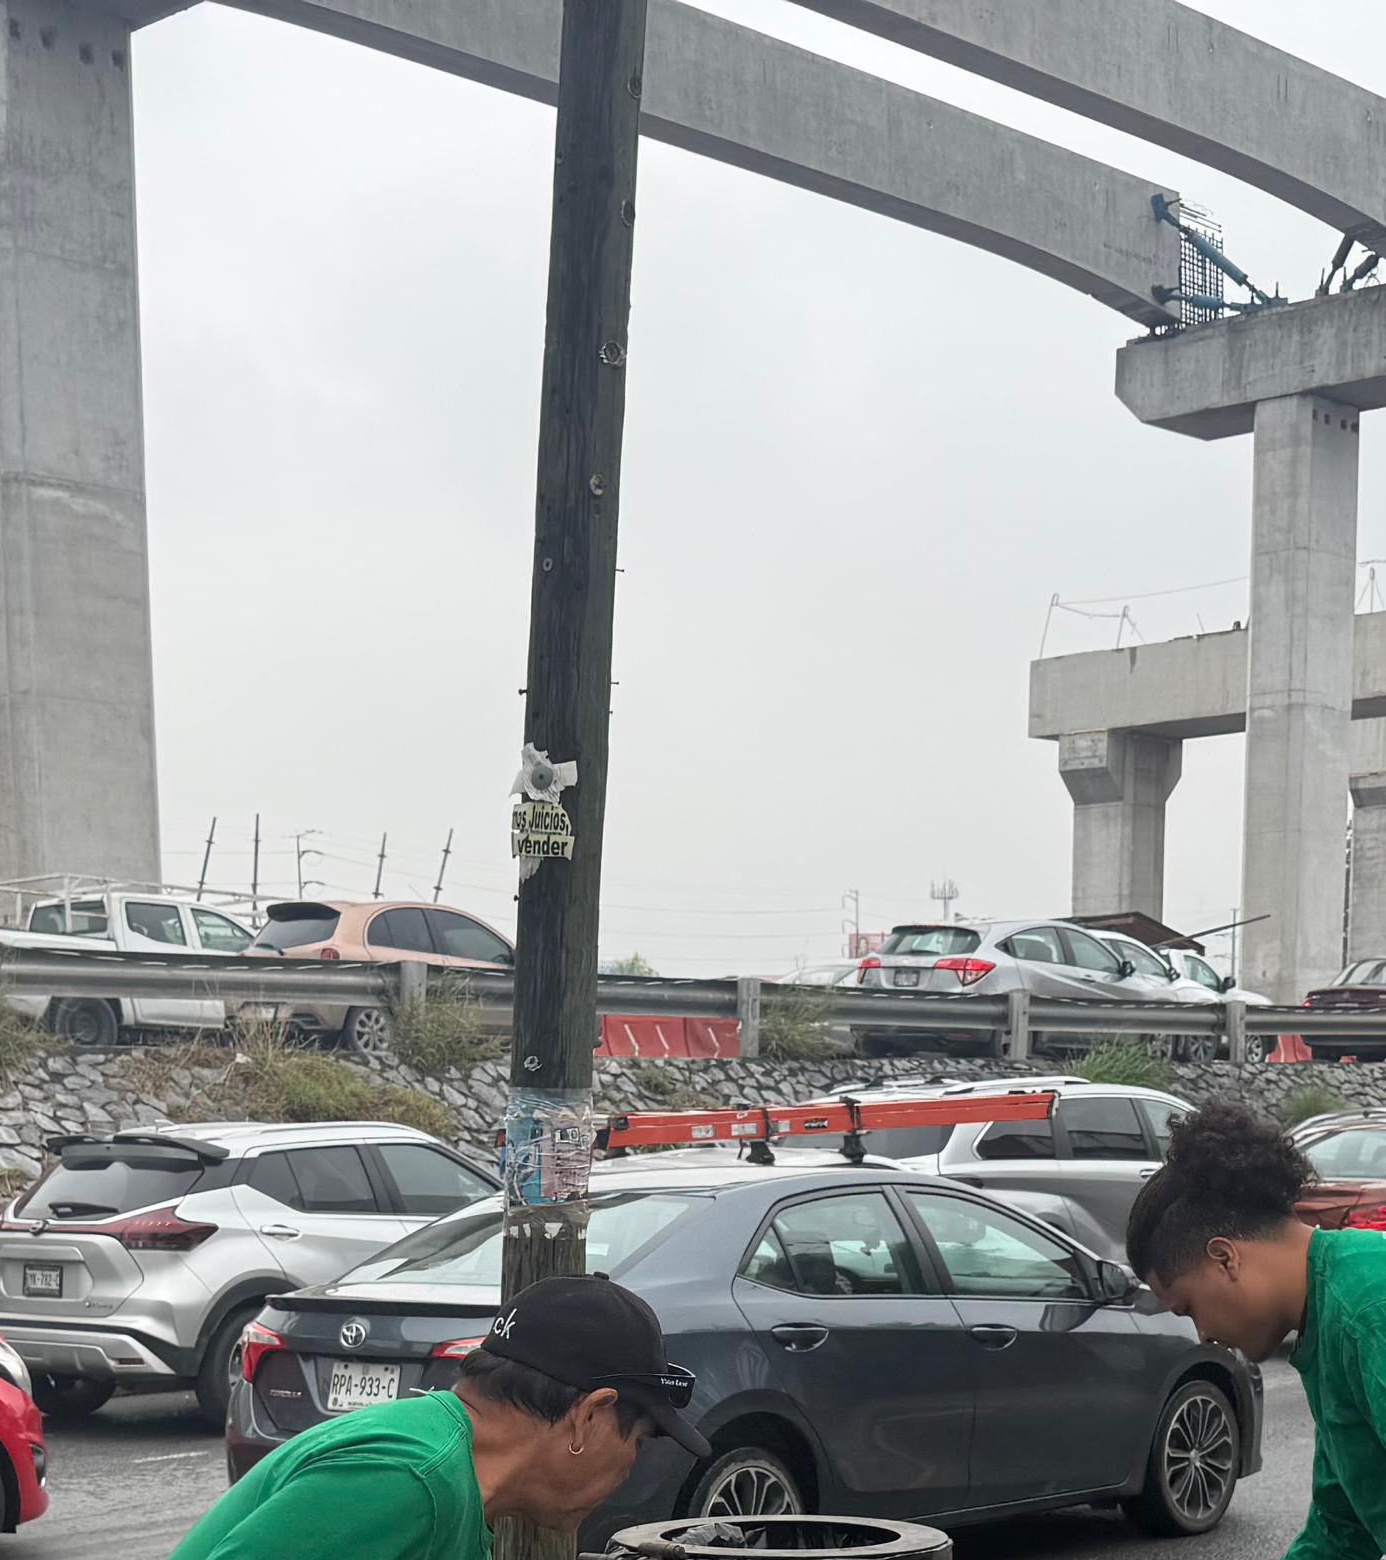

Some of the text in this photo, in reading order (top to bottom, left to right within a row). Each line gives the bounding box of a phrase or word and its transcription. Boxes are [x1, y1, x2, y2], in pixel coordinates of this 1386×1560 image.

[529, 805, 569, 835] Juicios,
[518, 835, 568, 856] vender
[331, 1374, 395, 1398] RPA-933-C
